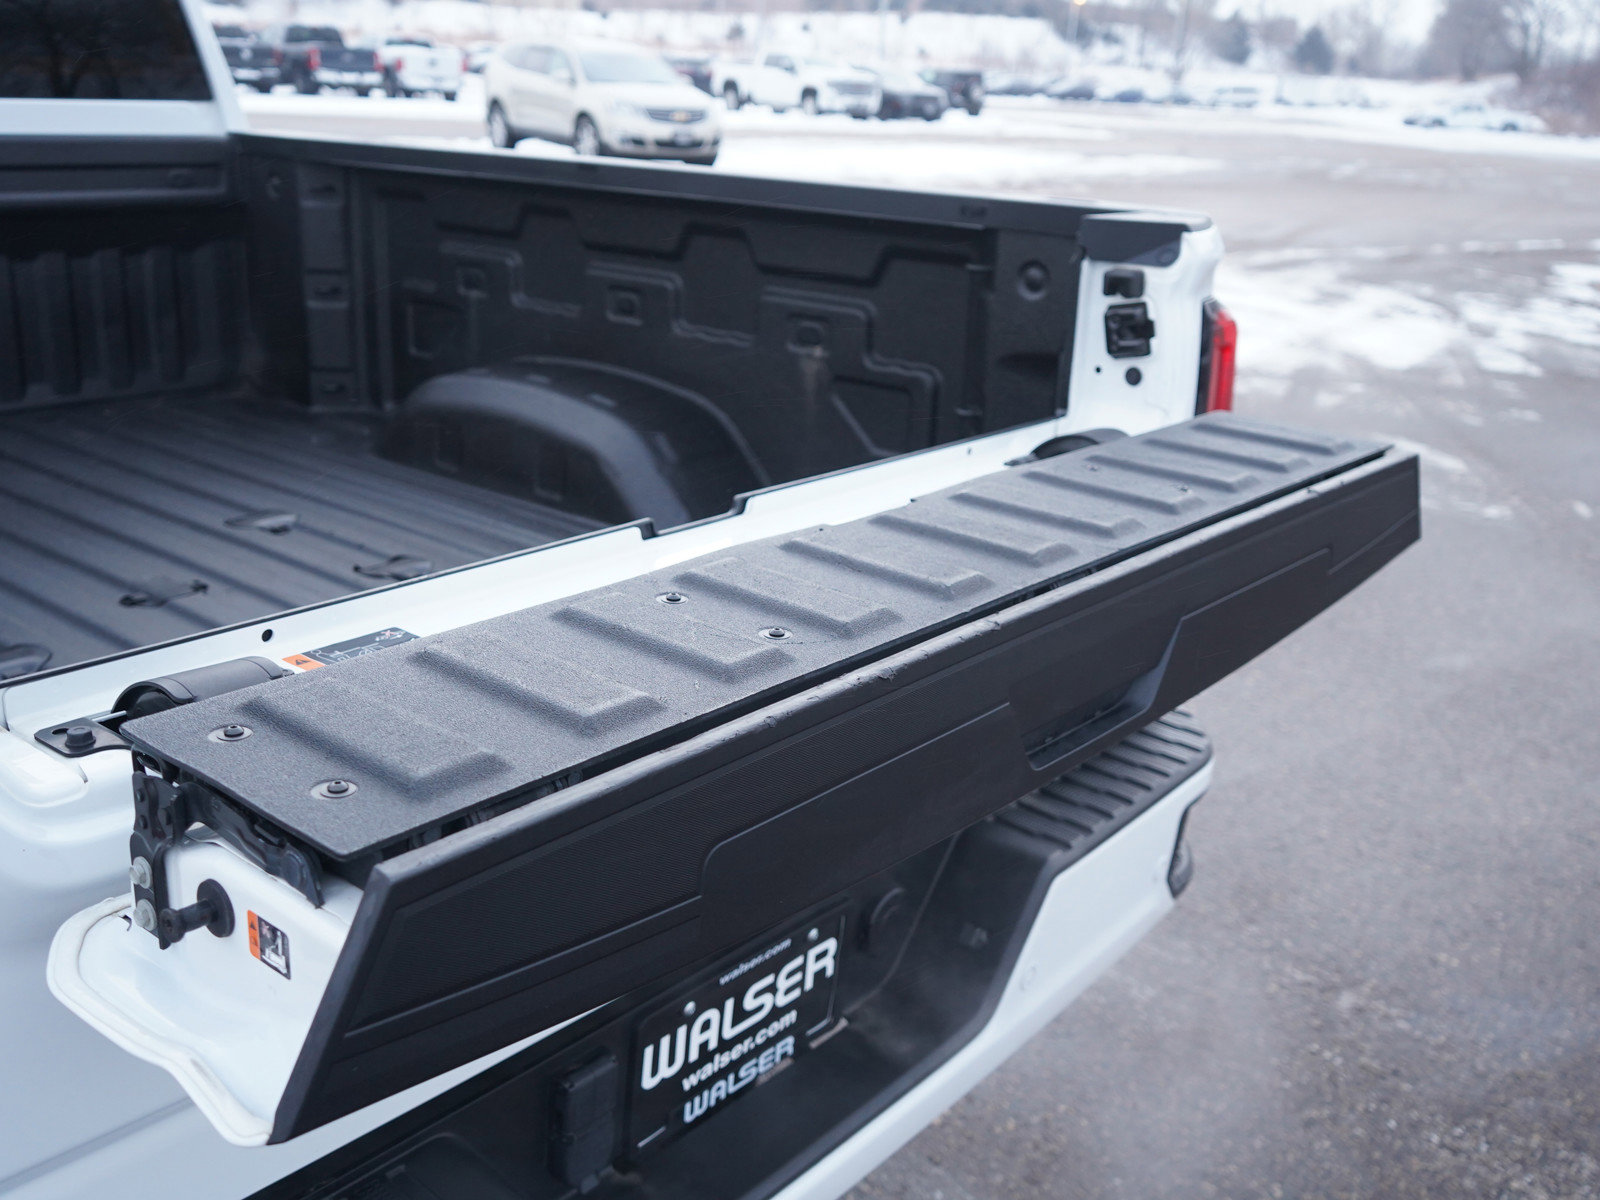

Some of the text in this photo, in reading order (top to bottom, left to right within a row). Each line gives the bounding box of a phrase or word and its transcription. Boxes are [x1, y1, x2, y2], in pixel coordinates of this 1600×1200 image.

[719, 938, 792, 986] walser.com
[641, 937, 838, 1091] WALSER
[682, 1009, 798, 1092] walser.com
[683, 1035, 796, 1124] WALSER
